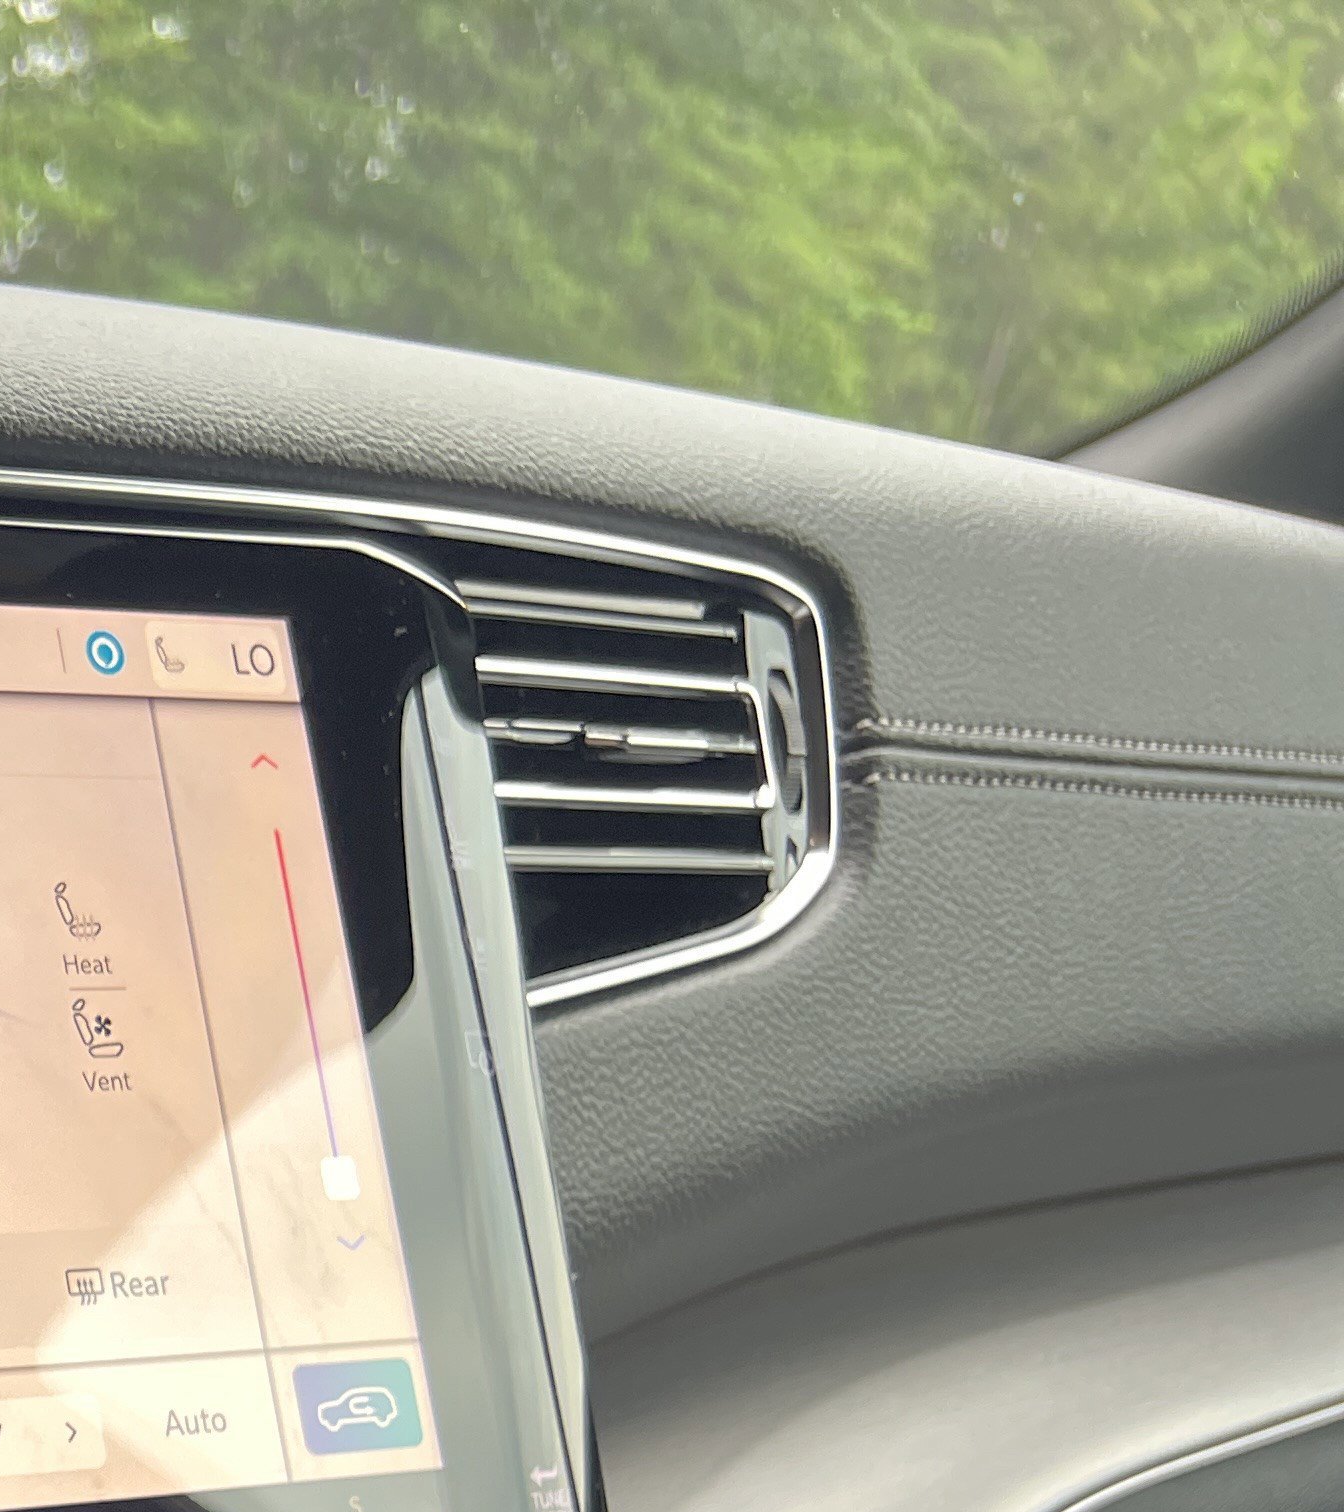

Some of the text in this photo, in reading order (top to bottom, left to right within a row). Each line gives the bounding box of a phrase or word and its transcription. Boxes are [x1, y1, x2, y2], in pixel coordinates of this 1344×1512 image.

[231, 643, 275, 678] LO
[62, 953, 112, 977] Heat
[81, 1070, 133, 1094] Vent
[109, 1271, 171, 1300] Rear
[164, 1407, 228, 1438] Auto
